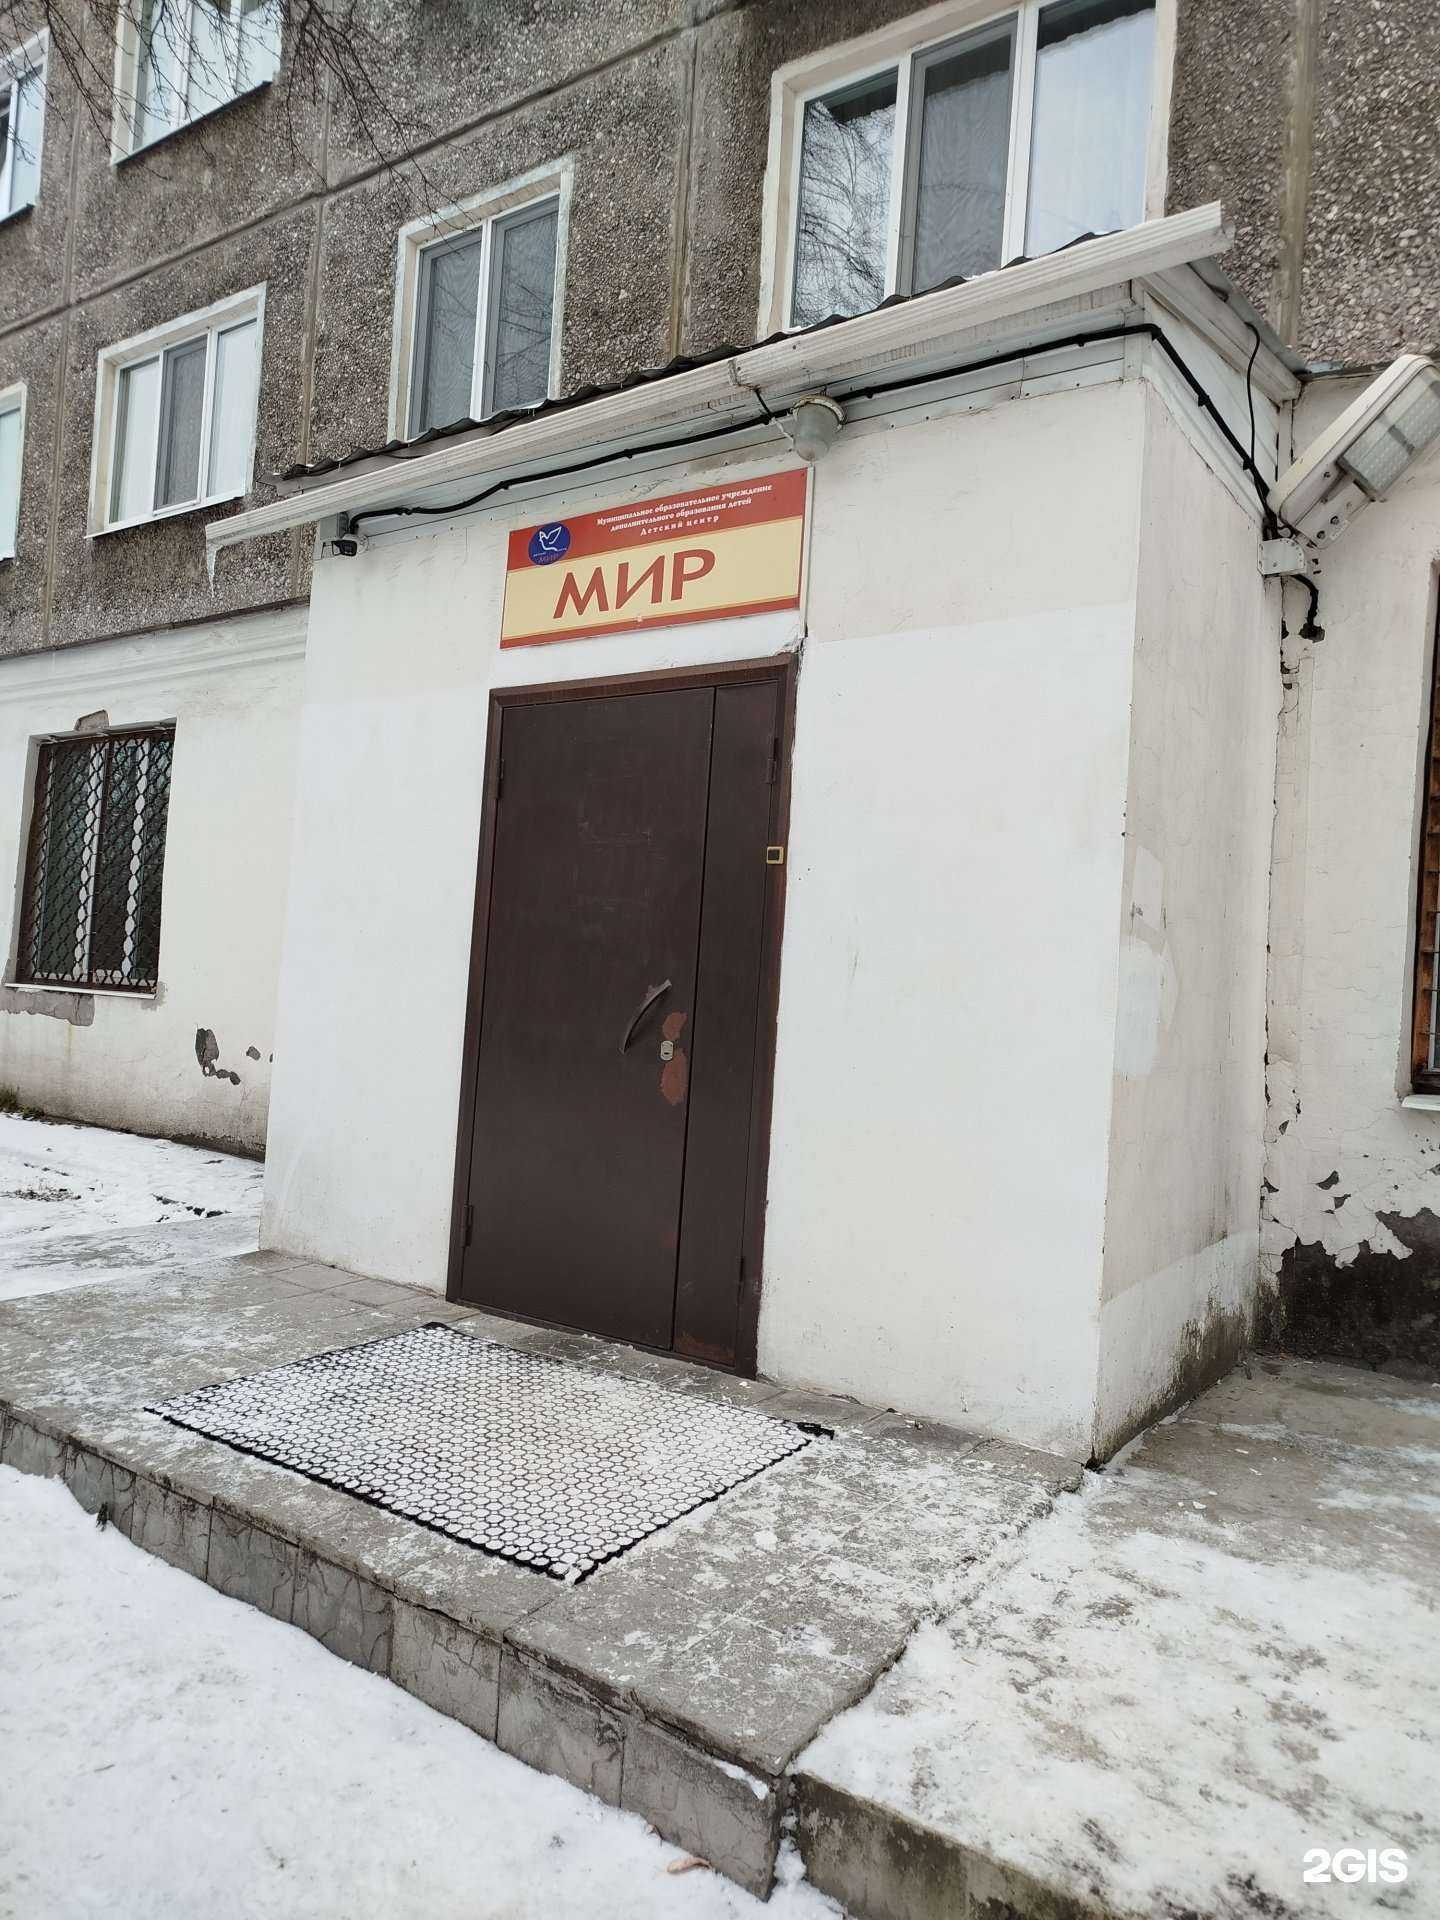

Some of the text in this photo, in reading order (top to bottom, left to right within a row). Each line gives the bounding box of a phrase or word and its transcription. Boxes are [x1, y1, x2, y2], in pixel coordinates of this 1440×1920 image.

[597, 485, 773, 526] Муниципальное образовательное учреждение
[610, 513, 675, 533] дополнительного
[728, 497, 752, 509] детей
[640, 515, 719, 537] Детский центр
[553, 549, 716, 619] МИР
